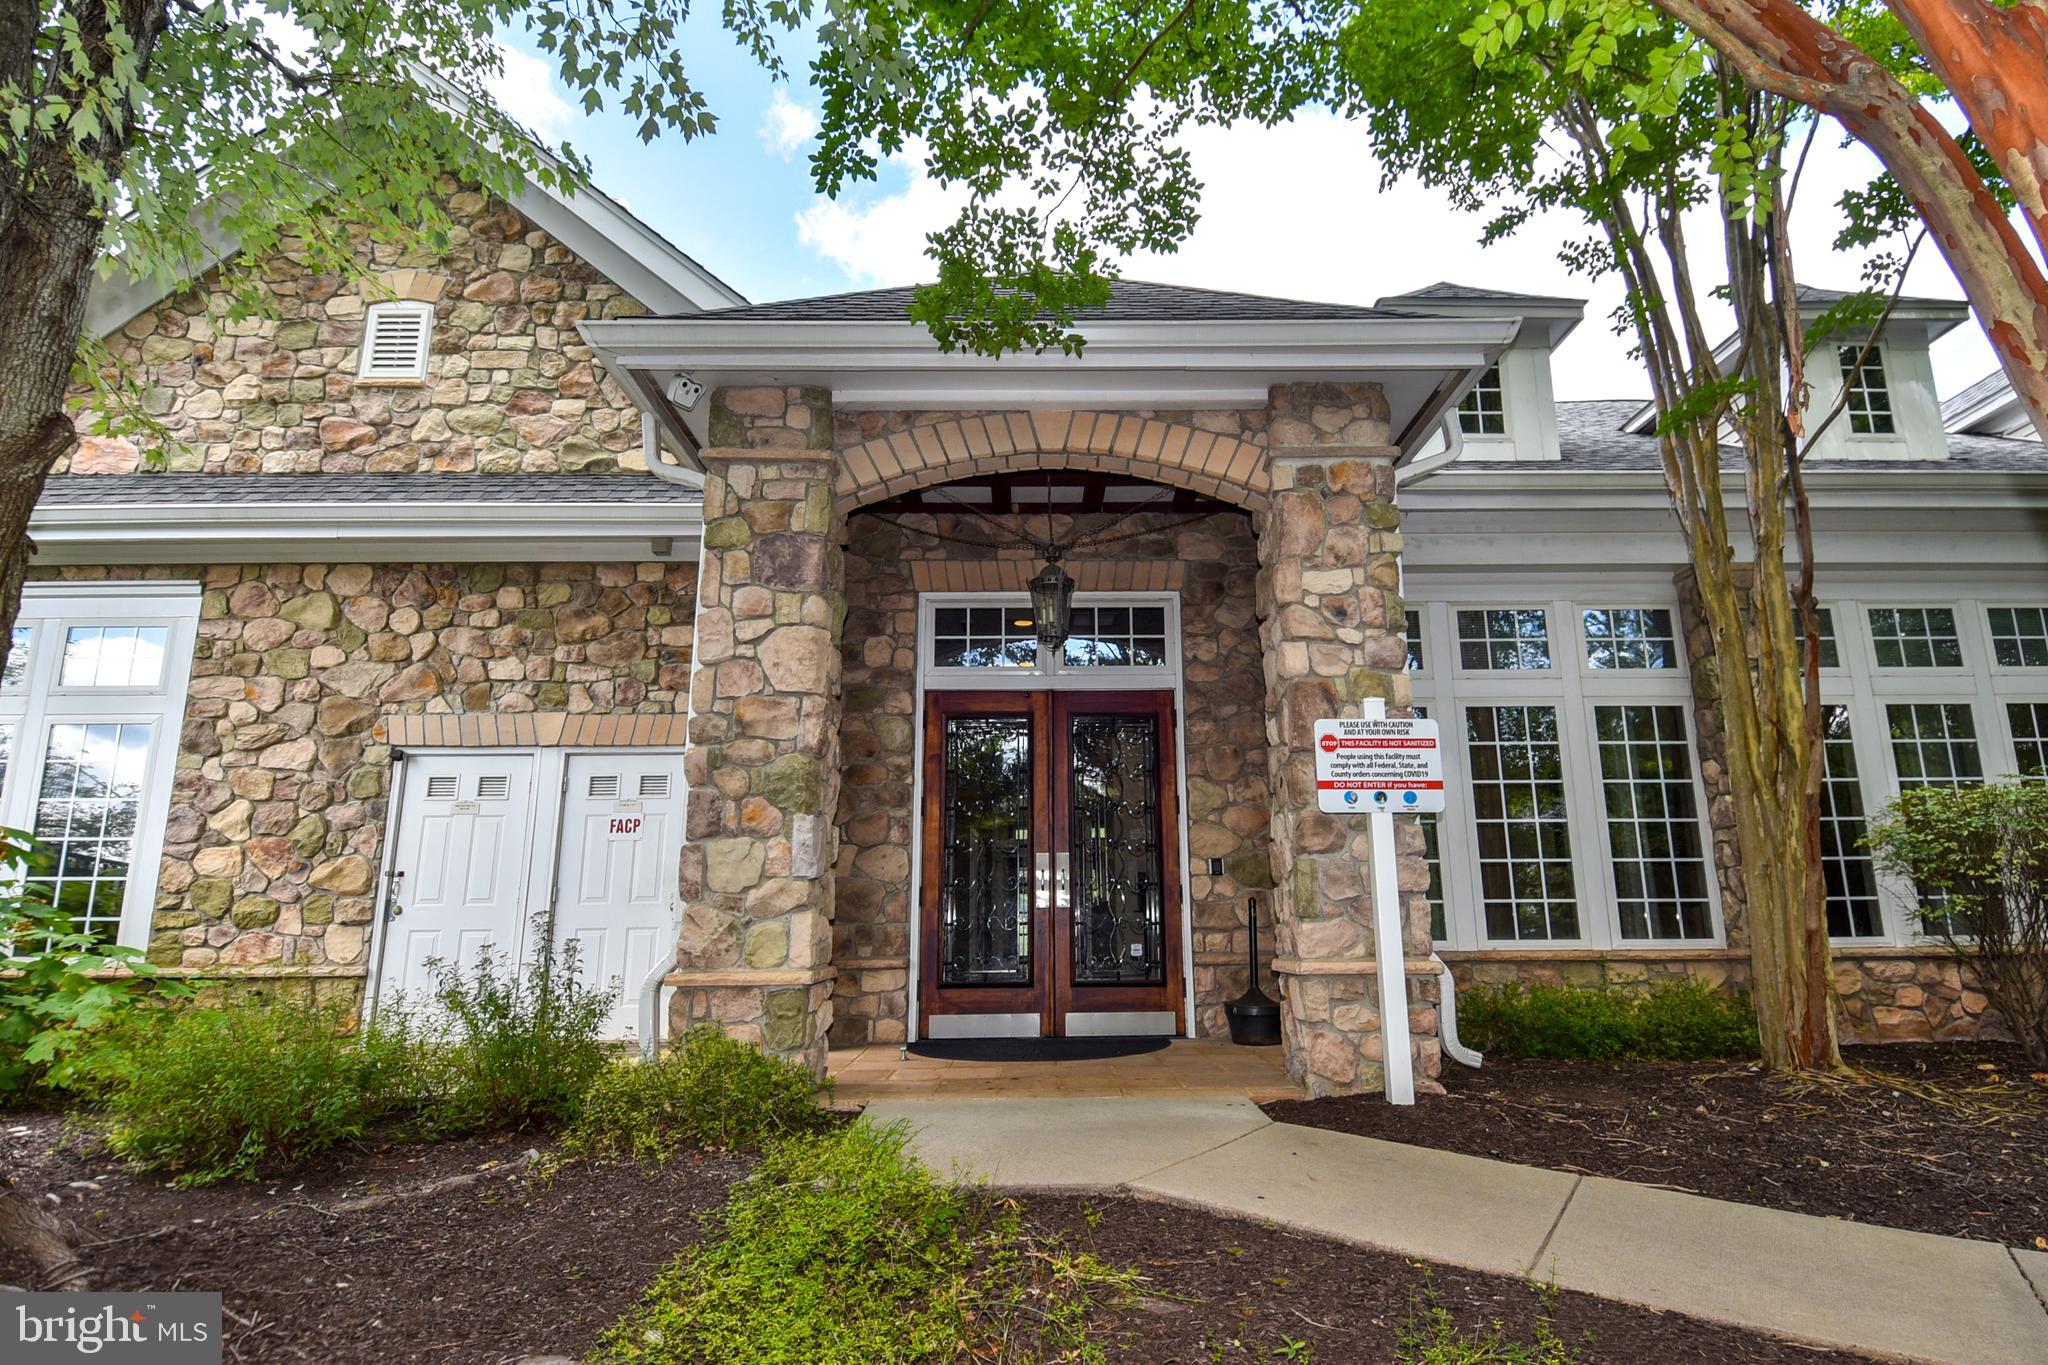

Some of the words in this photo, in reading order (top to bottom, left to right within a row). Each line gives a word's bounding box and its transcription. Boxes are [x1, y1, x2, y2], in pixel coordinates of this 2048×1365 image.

[1337, 753, 1357, 761] People
[1386, 753, 1405, 761] facility
[1330, 762, 1351, 770] comply
[1375, 762, 1397, 770] Federal,
[1331, 770, 1351, 778] County
[610, 818, 641, 833] FACP
